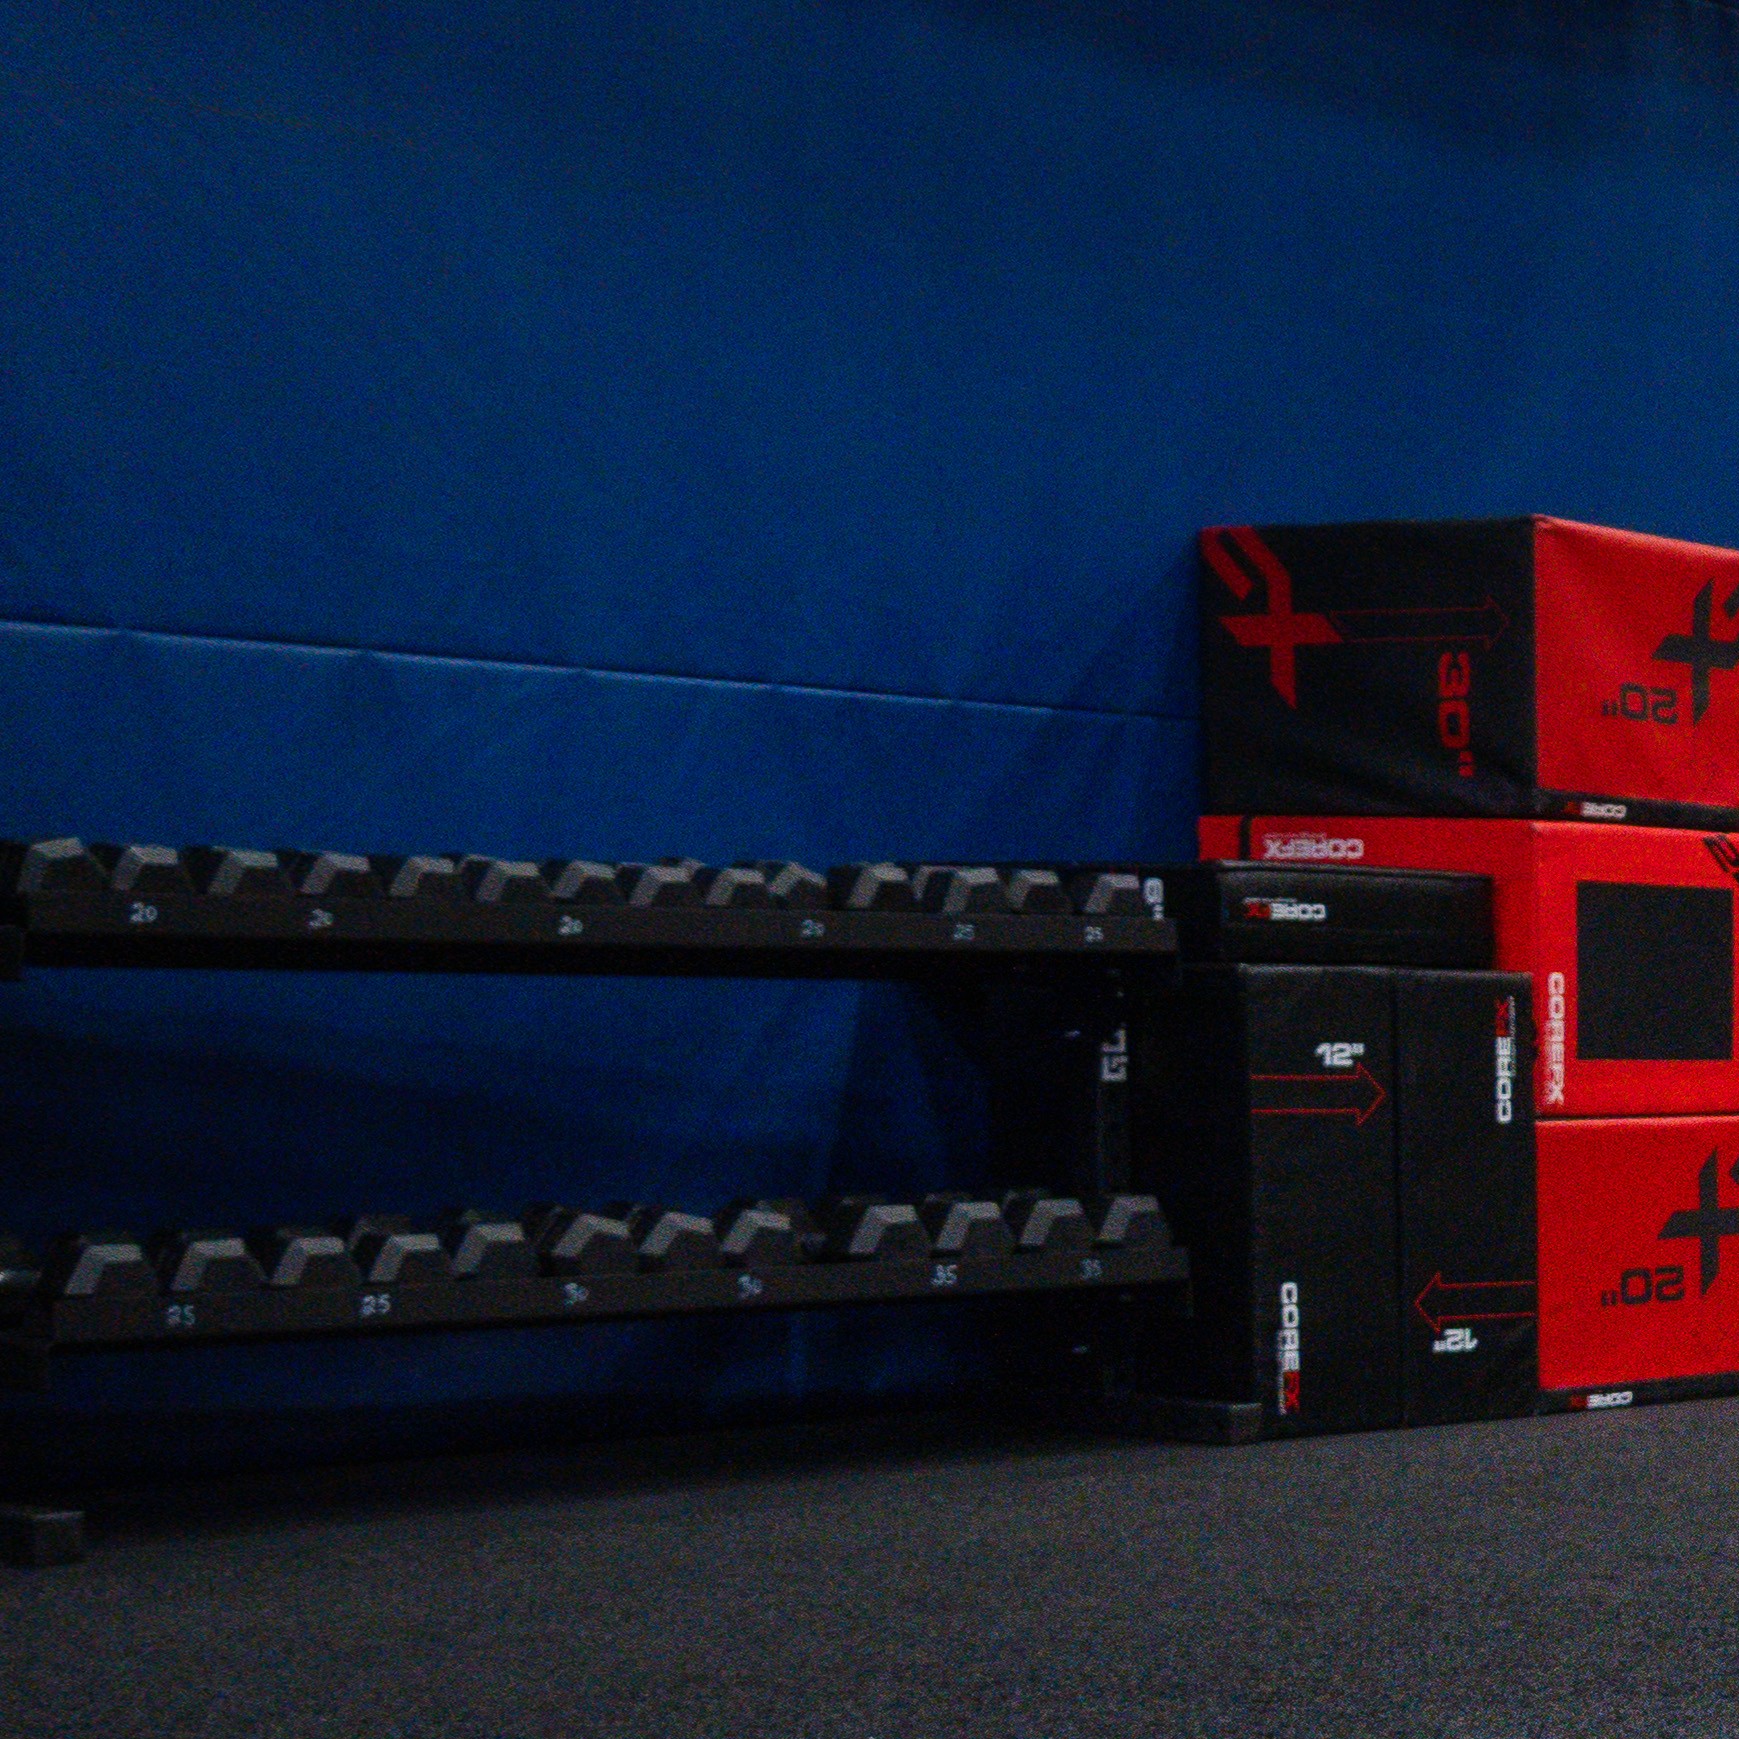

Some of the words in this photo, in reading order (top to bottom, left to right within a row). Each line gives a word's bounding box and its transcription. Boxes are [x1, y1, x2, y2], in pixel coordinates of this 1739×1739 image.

[1438, 650, 1475, 777] 30"
[1601, 681, 1678, 725] 20"
[1261, 838, 1365, 859] COREFX
[129, 902, 159, 924] 20
[1245, 903, 1326, 921] COREFX
[1547, 971, 1565, 1105] COREFX
[1314, 1041, 1366, 1067] 12"
[1494, 998, 1512, 1124] COREFX
[930, 1263, 957, 1287] 35
[1601, 1265, 1686, 1307] 20"
[166, 1304, 196, 1327] 25
[361, 1292, 391, 1318] 25
[1280, 1281, 1301, 1413] COREFX
[1431, 1326, 1478, 1354] 12"
